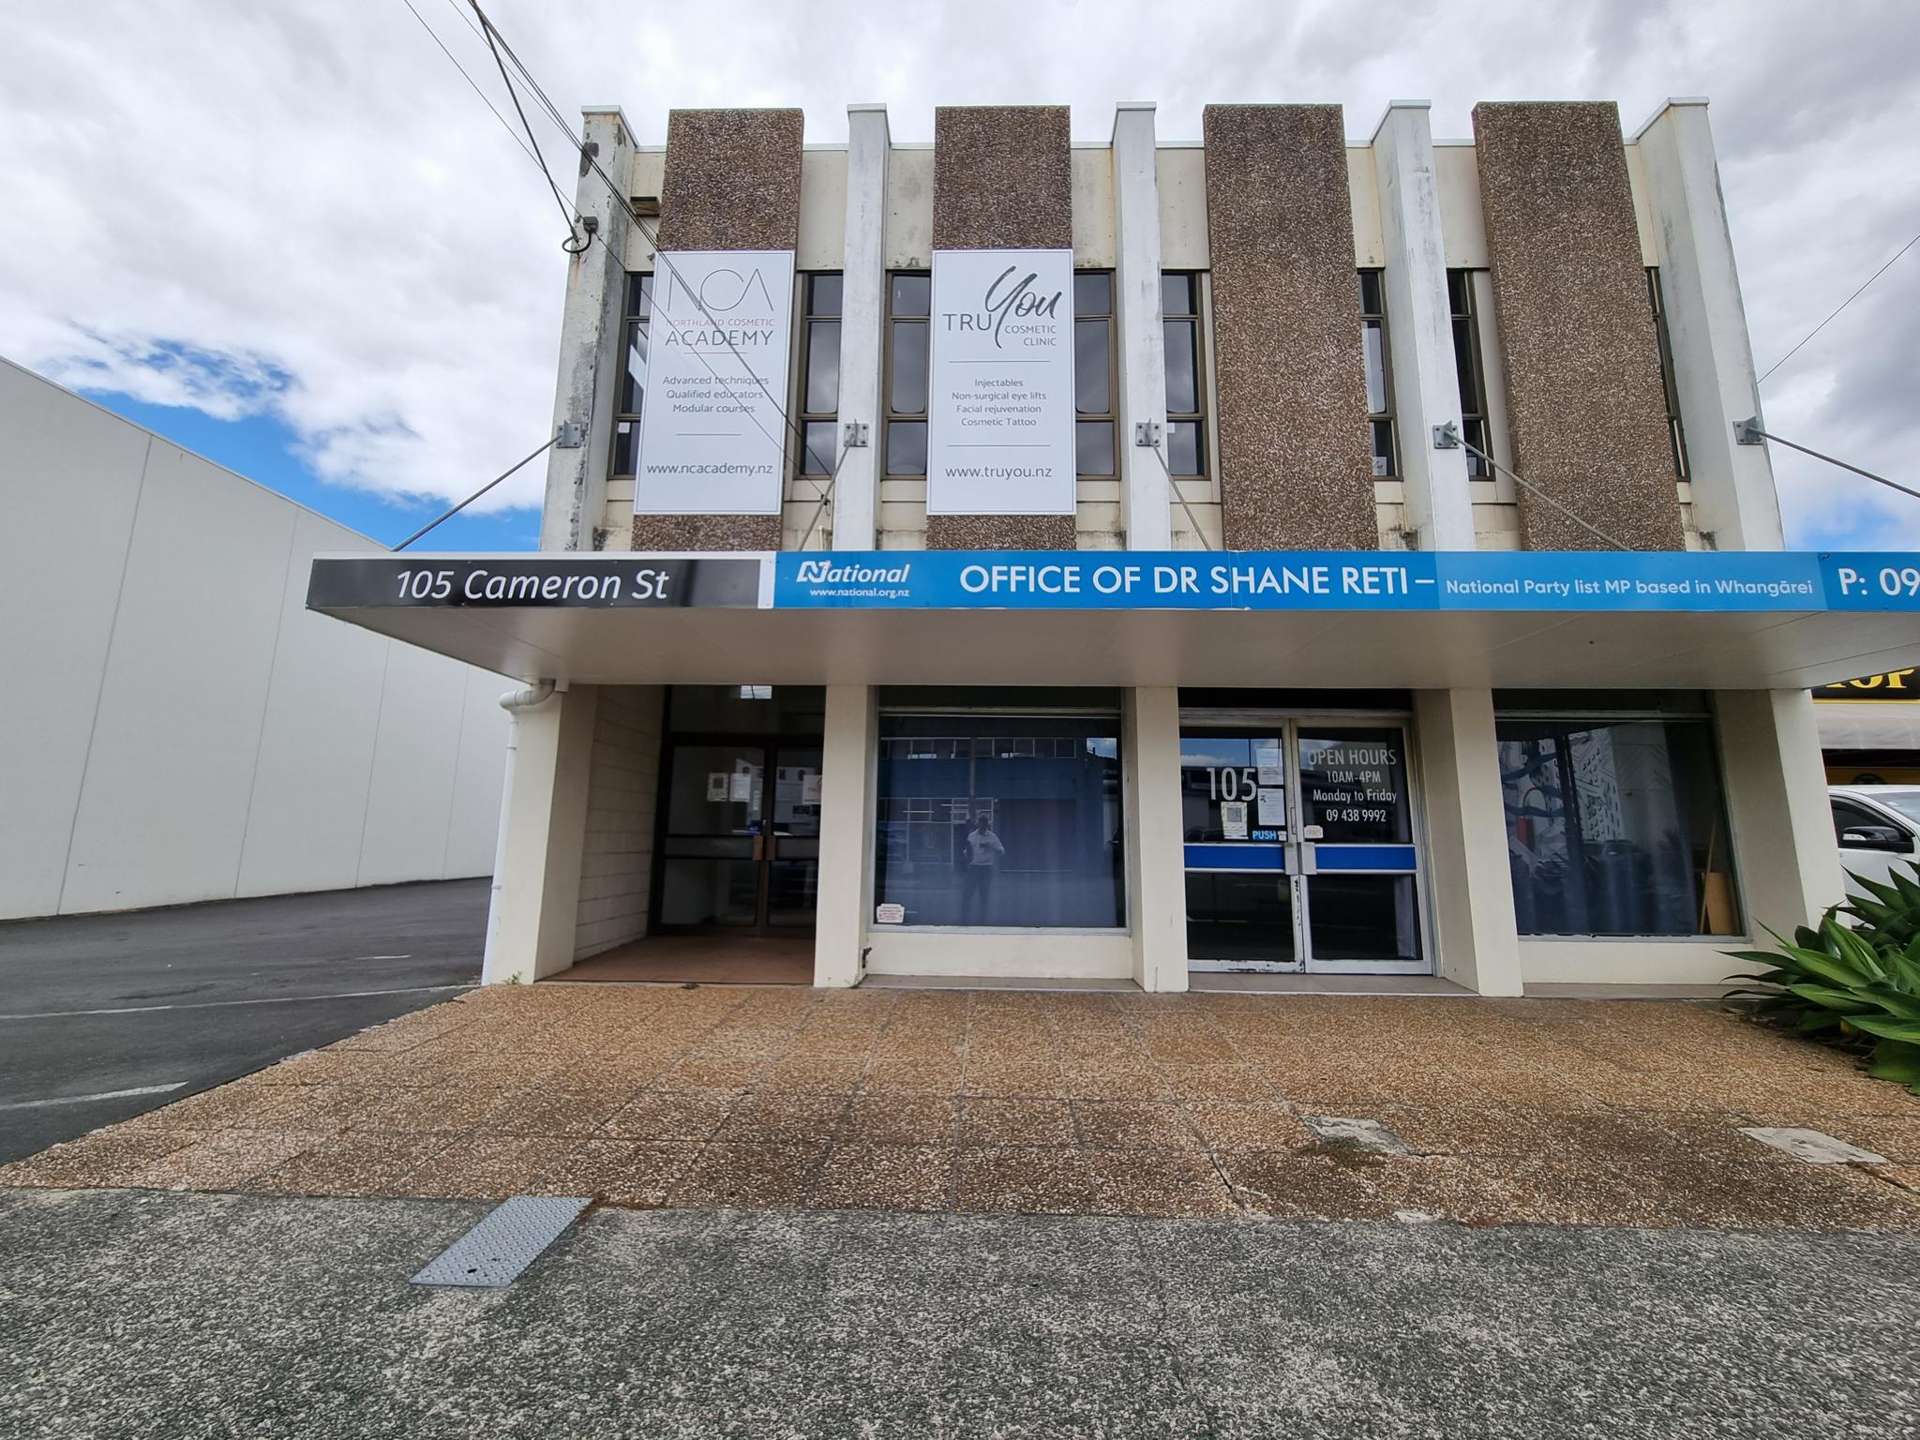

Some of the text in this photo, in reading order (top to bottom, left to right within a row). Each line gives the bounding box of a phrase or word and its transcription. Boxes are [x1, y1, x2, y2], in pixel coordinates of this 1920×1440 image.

[942, 265, 1062, 349] TRU You
[727, 319, 775, 327] COSMETIC
[1004, 325, 1056, 334] COSMETIC
[665, 330, 773, 346] ACADEMY
[1023, 337, 1056, 346] CLINIC
[662, 376, 769, 387] Advanced techniques
[975, 379, 1023, 388] Injectables
[666, 389, 763, 399] Qualified educators
[952, 392, 1009, 401] Non-surgical
[1030, 392, 1047, 400] lifts
[672, 404, 713, 413] Modular
[956, 405, 1042, 415] Facial rejuvenation
[961, 418, 1037, 426] Cosmetic Tattoo
[646, 463, 774, 476] www.ncacademy.nz
[945, 467, 1053, 480] www.truyou.nz
[796, 560, 911, 583] National
[397, 569, 670, 600] 105 Cameron St
[959, 565, 1080, 593] OFFICE
[1092, 566, 1141, 594] OF
[1153, 566, 1200, 594] DR
[1211, 566, 1330, 595] SHANE
[1342, 567, 1408, 595] RETI
[1838, 568, 1920, 597] P: 09
[810, 587, 910, 599] www.national.org.nz
[1446, 579, 1813, 597] National Party list MP based in Whangārei
[1308, 749, 1397, 766] OPEN HOURS
[1327, 770, 1382, 784] 10AM-4PM
[1206, 767, 1257, 801] 105
[1313, 788, 1397, 804] Monday to Friday
[1326, 809, 1386, 822] 09 438 9992
[1252, 830, 1277, 840] PUSH
